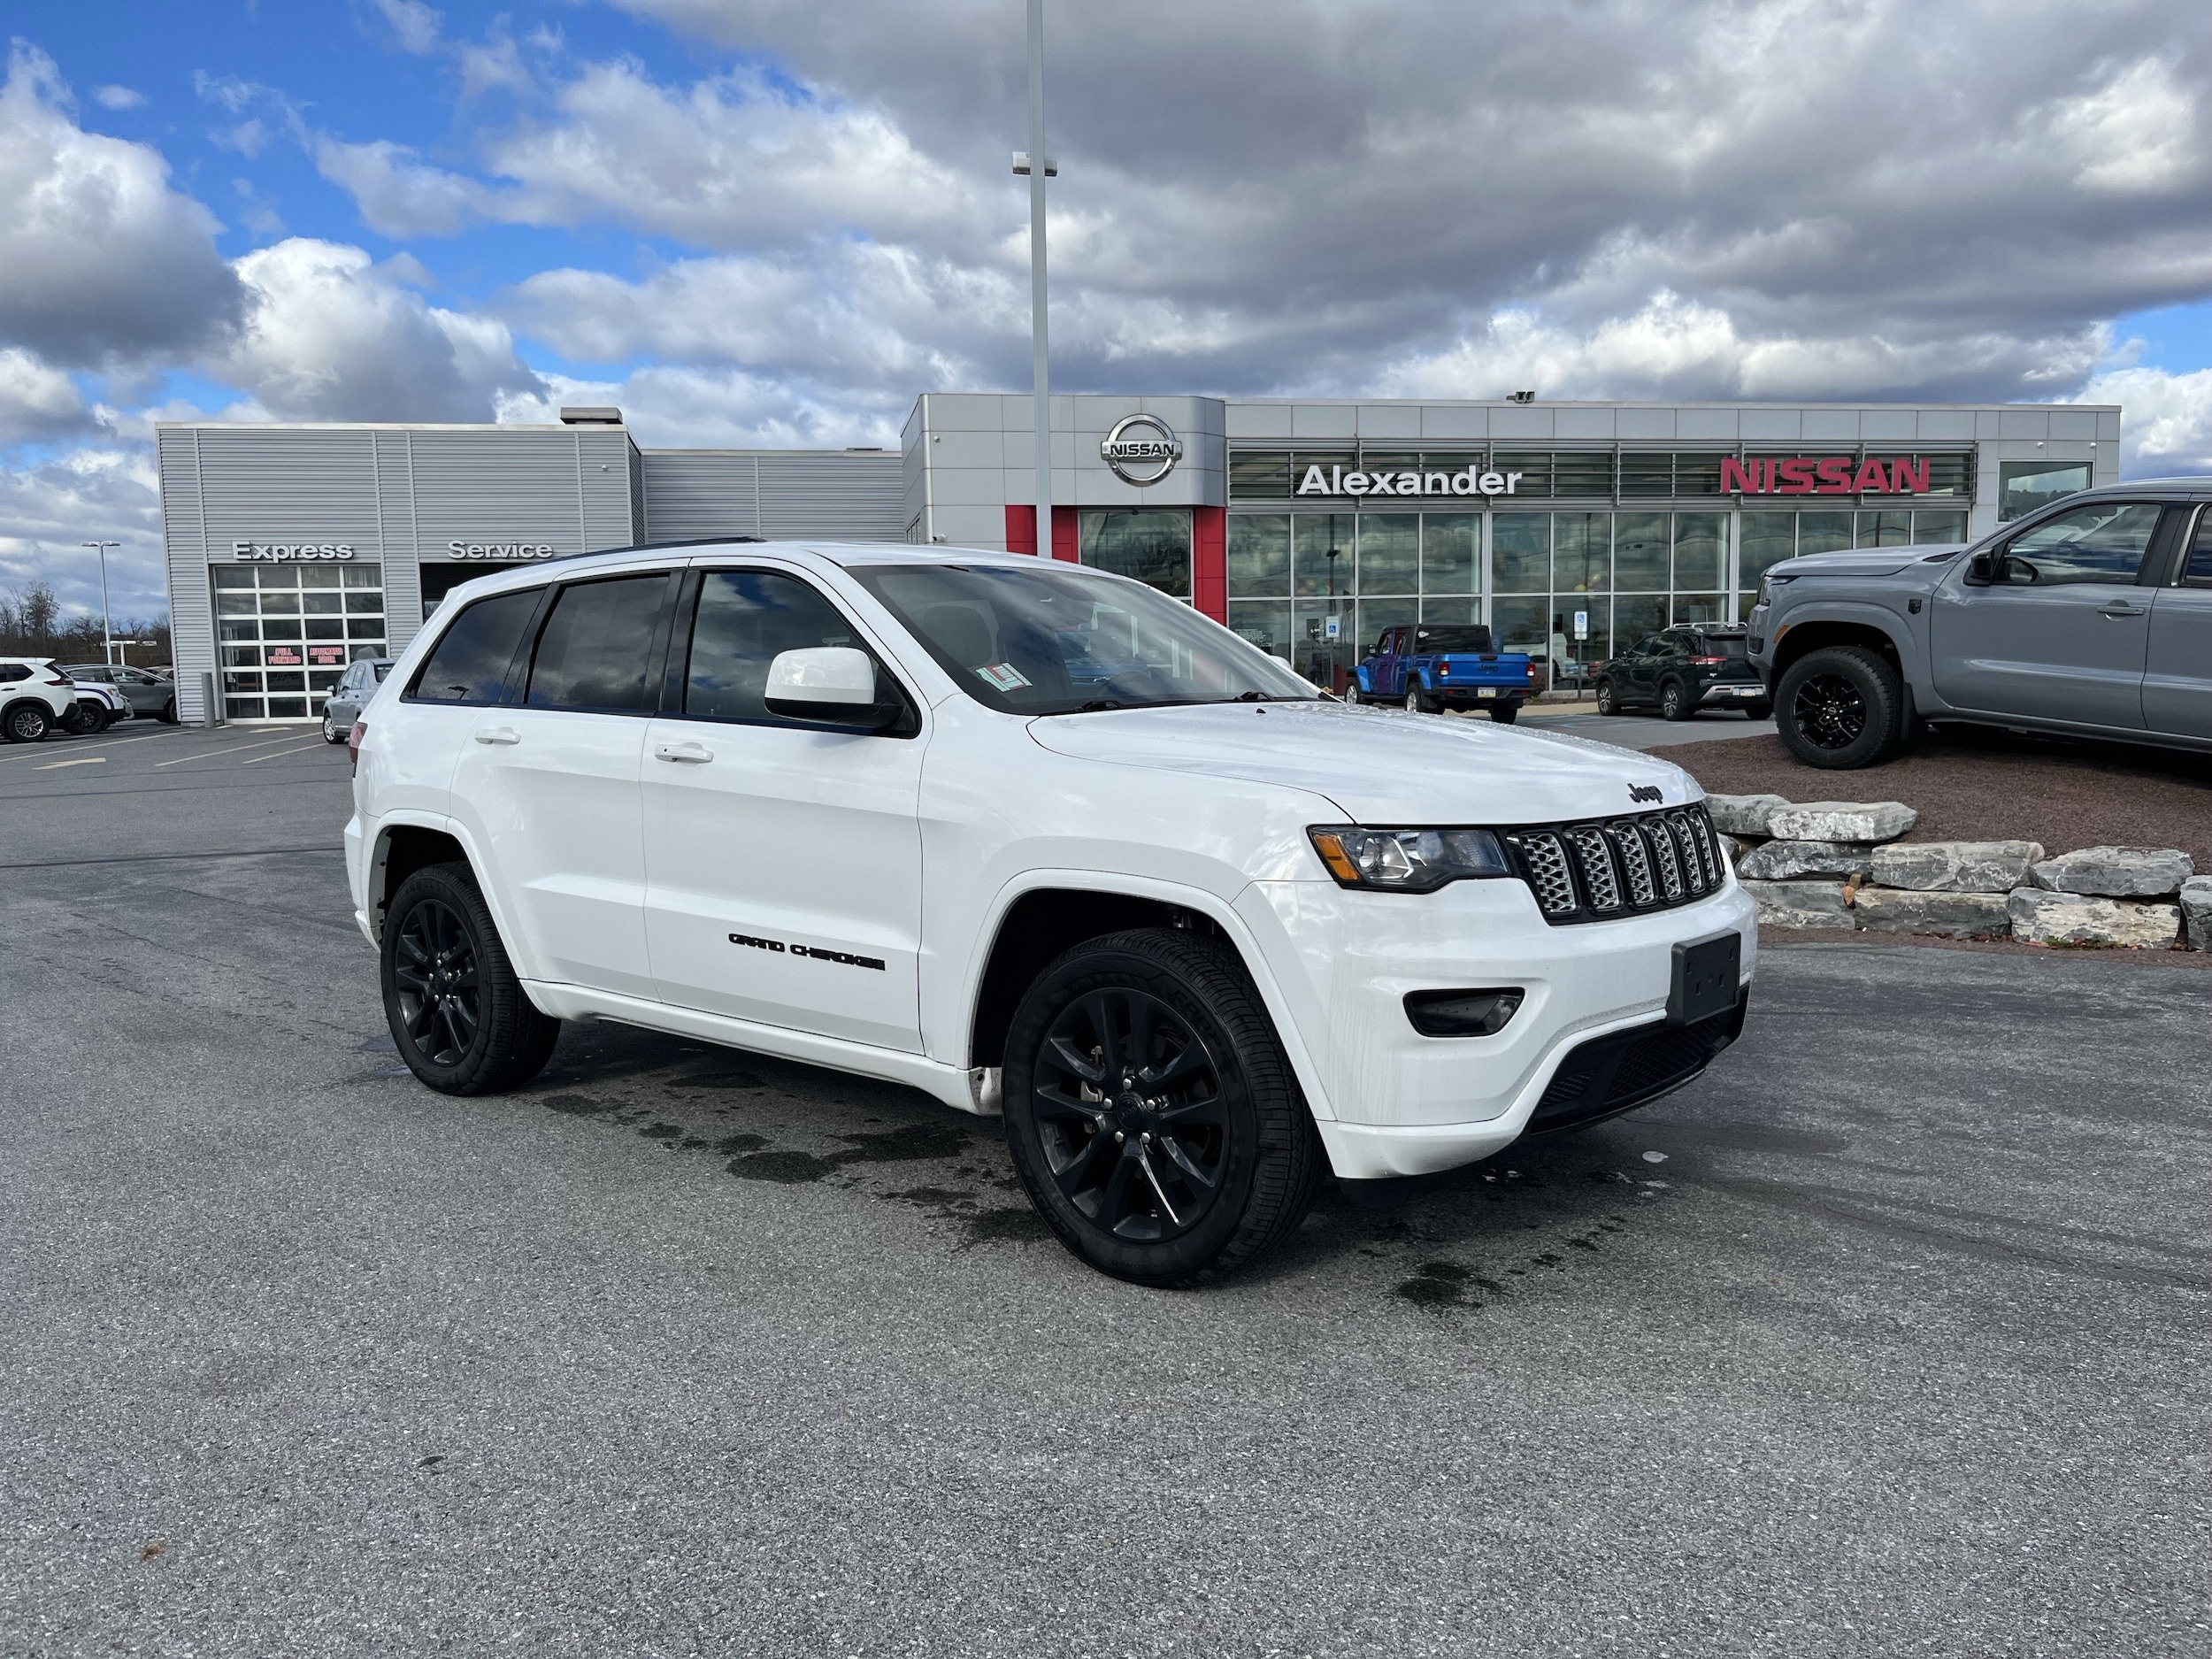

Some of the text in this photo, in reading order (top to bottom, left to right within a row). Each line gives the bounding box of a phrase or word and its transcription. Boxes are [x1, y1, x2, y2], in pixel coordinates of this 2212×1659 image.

[1110, 443, 1175, 457] NISSAN
[1297, 465, 1523, 495] Alexander
[1720, 458, 1930, 494] NISSAN
[232, 541, 353, 564] Express
[448, 540, 553, 559] Service
[268, 656, 301, 664] FORWARD
[1478, 664, 1498, 672] Jeep
[1627, 783, 1663, 804] Jeep
[728, 933, 886, 972] GRAND CHEROKEE
